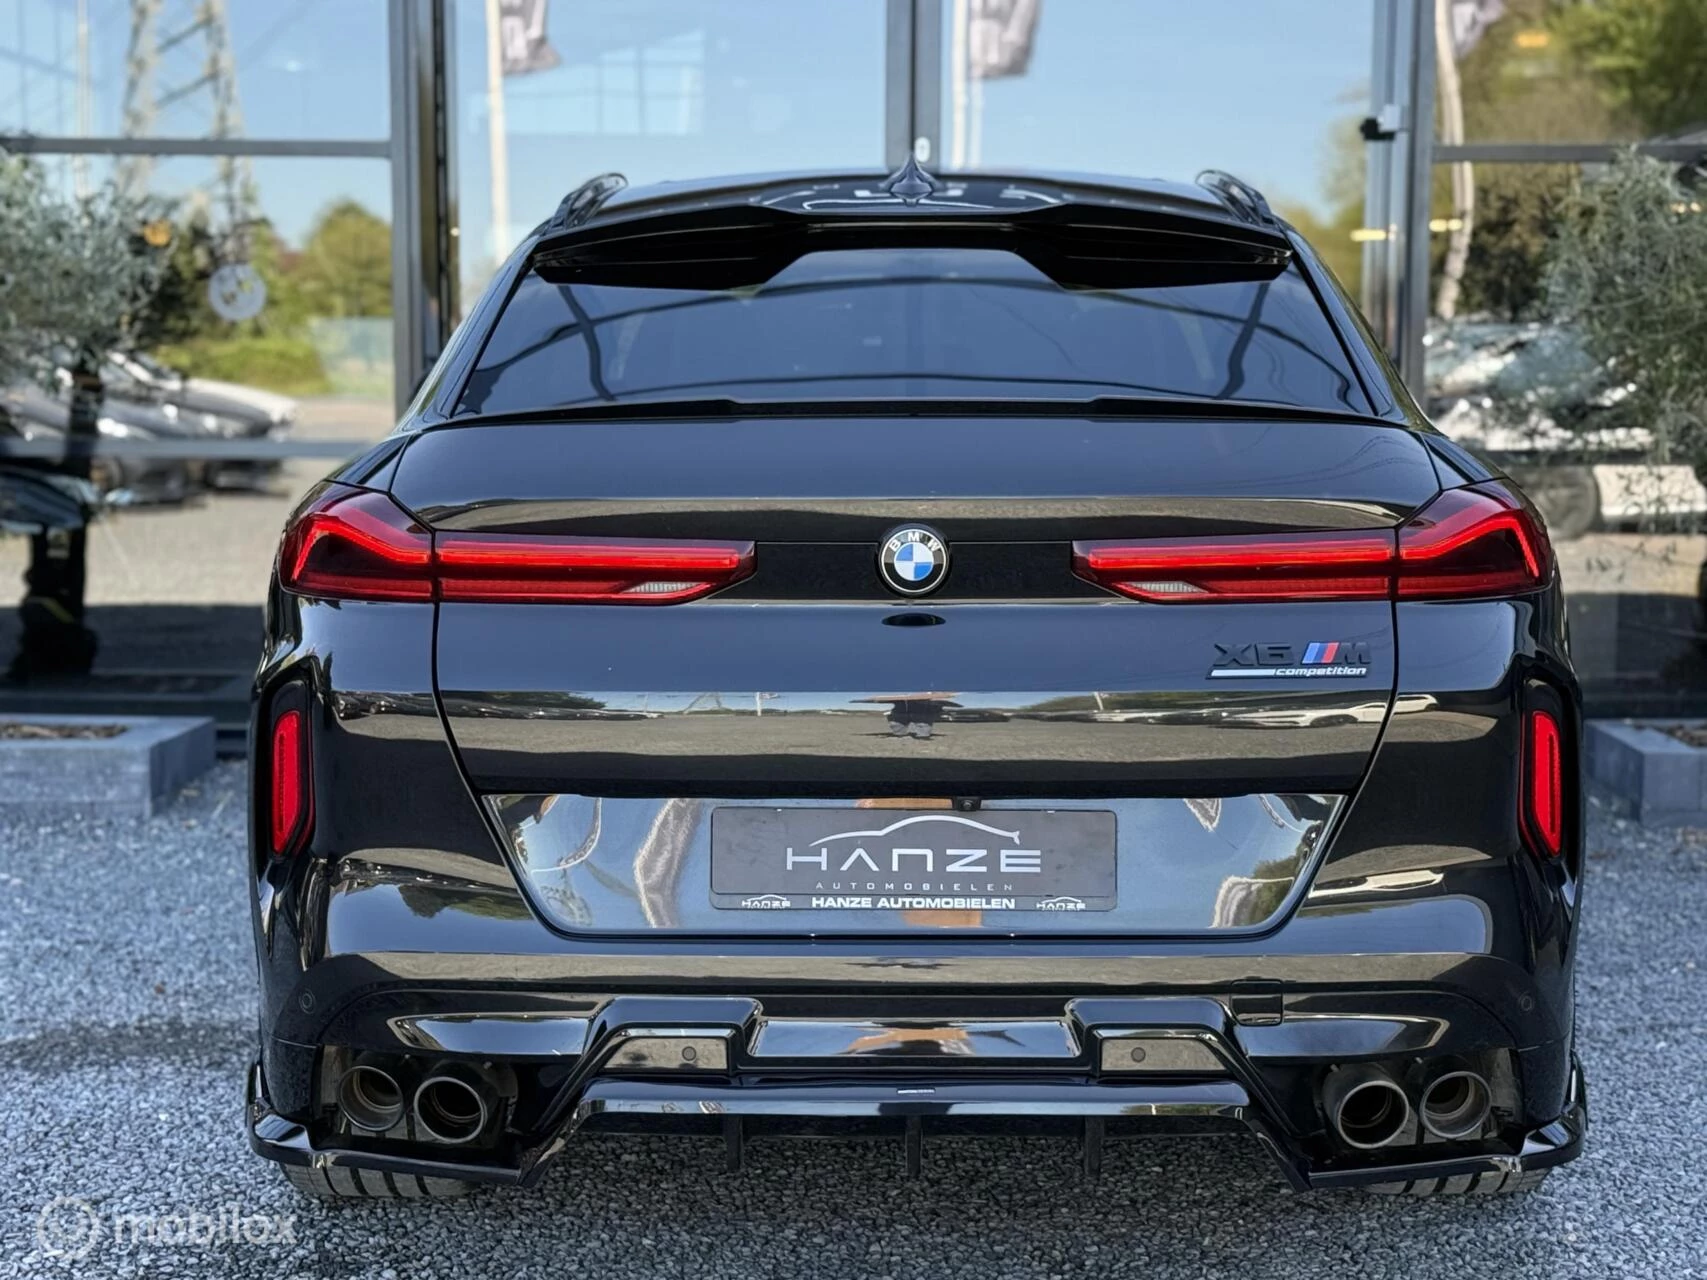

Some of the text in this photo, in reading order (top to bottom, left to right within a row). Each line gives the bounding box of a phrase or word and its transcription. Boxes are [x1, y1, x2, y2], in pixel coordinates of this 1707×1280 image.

[889, 532, 941, 552] BMW
[1213, 643, 1294, 667] X6
[1276, 667, 1367, 677] competition
[786, 847, 1042, 873] HANZE
[815, 881, 1013, 892] AUTOMOBIELEN
[811, 896, 1016, 910] HANZE AUTOMOBIELEN
